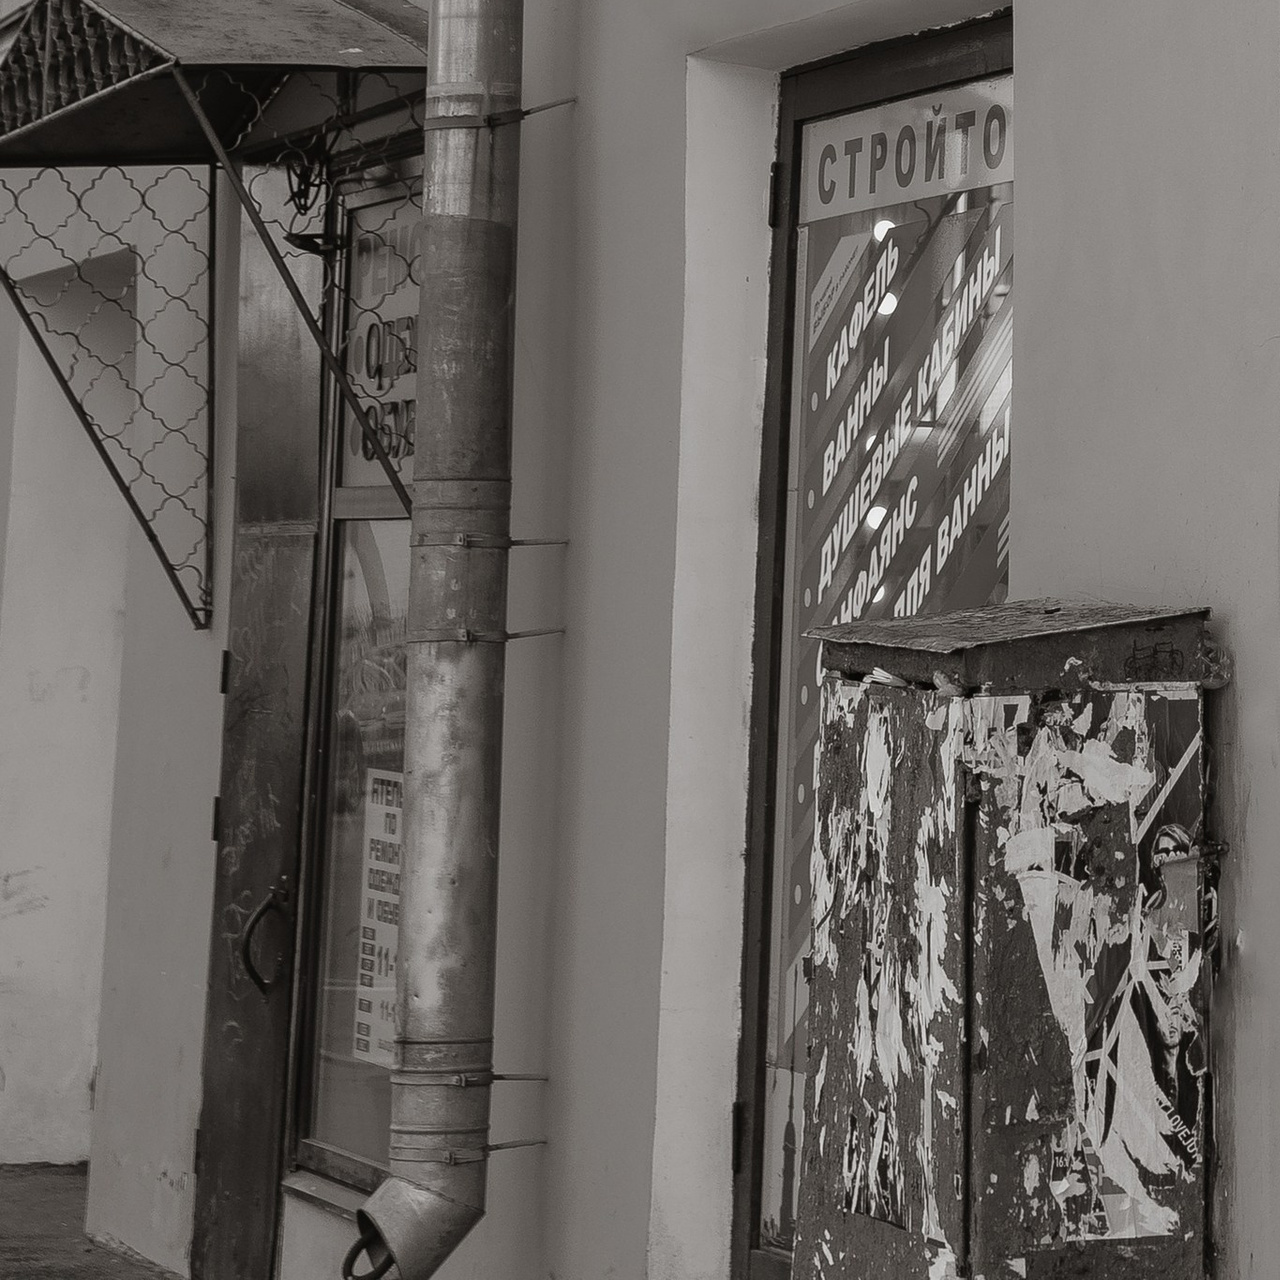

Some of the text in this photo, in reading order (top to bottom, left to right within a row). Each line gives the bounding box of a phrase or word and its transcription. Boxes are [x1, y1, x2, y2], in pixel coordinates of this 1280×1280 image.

[818, 104, 1007, 205] СТРОЙТО
[826, 238, 899, 400] КАФЕЛЬ
[817, 225, 1001, 605] ДУШЕВЫЕ КАБИНЫ
[822, 336, 890, 497] ВАННЫ
[936, 405, 1010, 575] ВАННЫ
[832, 475, 918, 625] НФАЯНС
